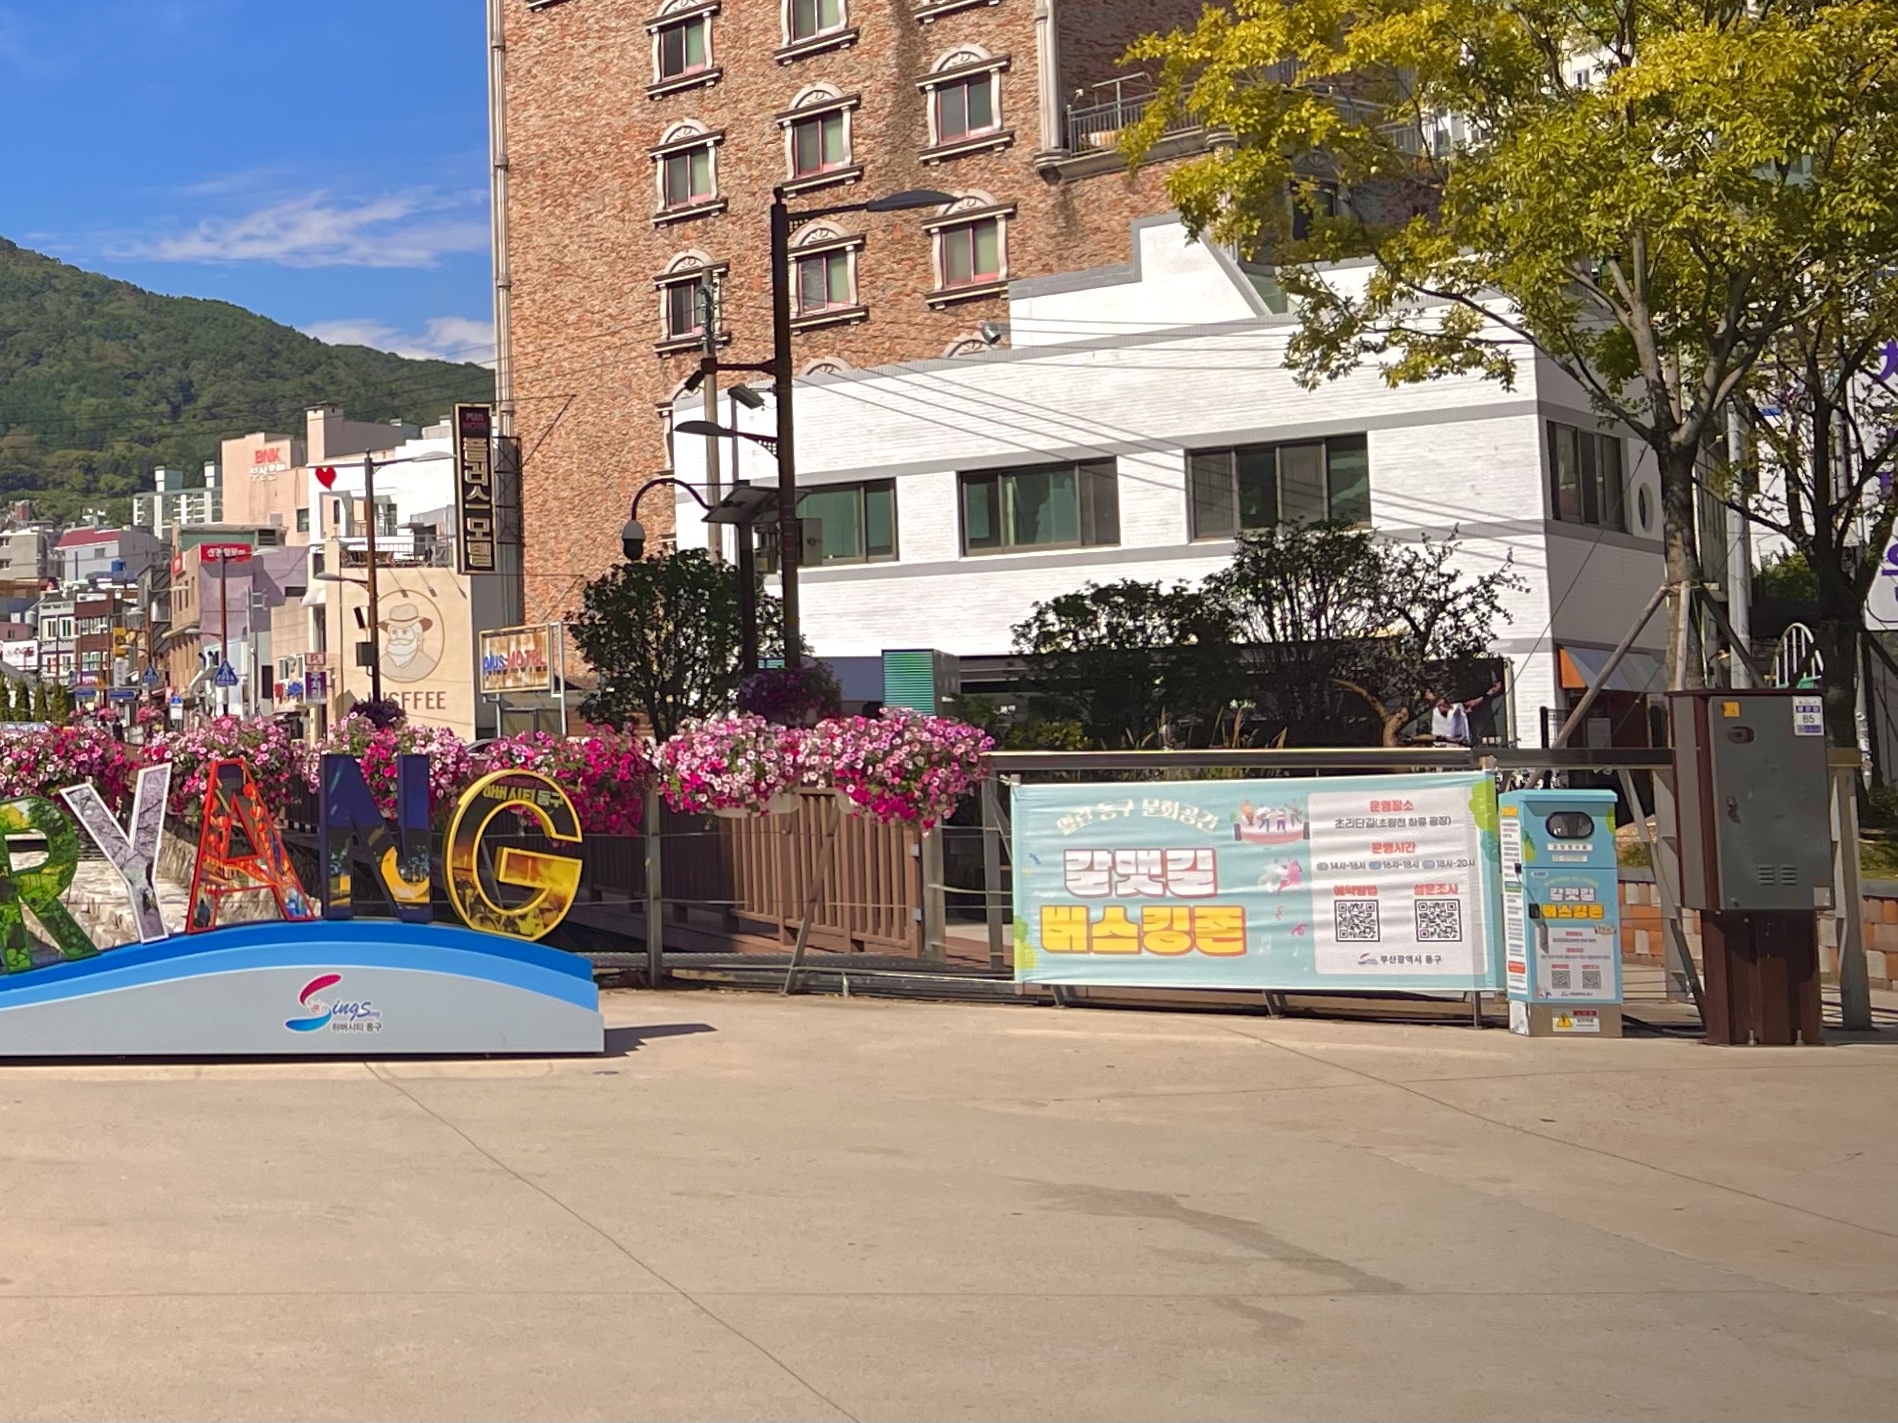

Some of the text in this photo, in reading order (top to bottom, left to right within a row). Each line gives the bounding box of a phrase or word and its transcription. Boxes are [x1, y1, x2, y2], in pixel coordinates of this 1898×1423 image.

[255, 447, 281, 464] BNK
[483, 649, 546, 672] plus MOTEL
[537, 789, 564, 808] 동구
[1096, 798, 1134, 821] 동구
[1142, 797, 1219, 834] 문화공간
[1063, 847, 1218, 898] 갈맷길
[1040, 904, 1248, 957] 버스킹존
[1425, 954, 1442, 964] 동구
